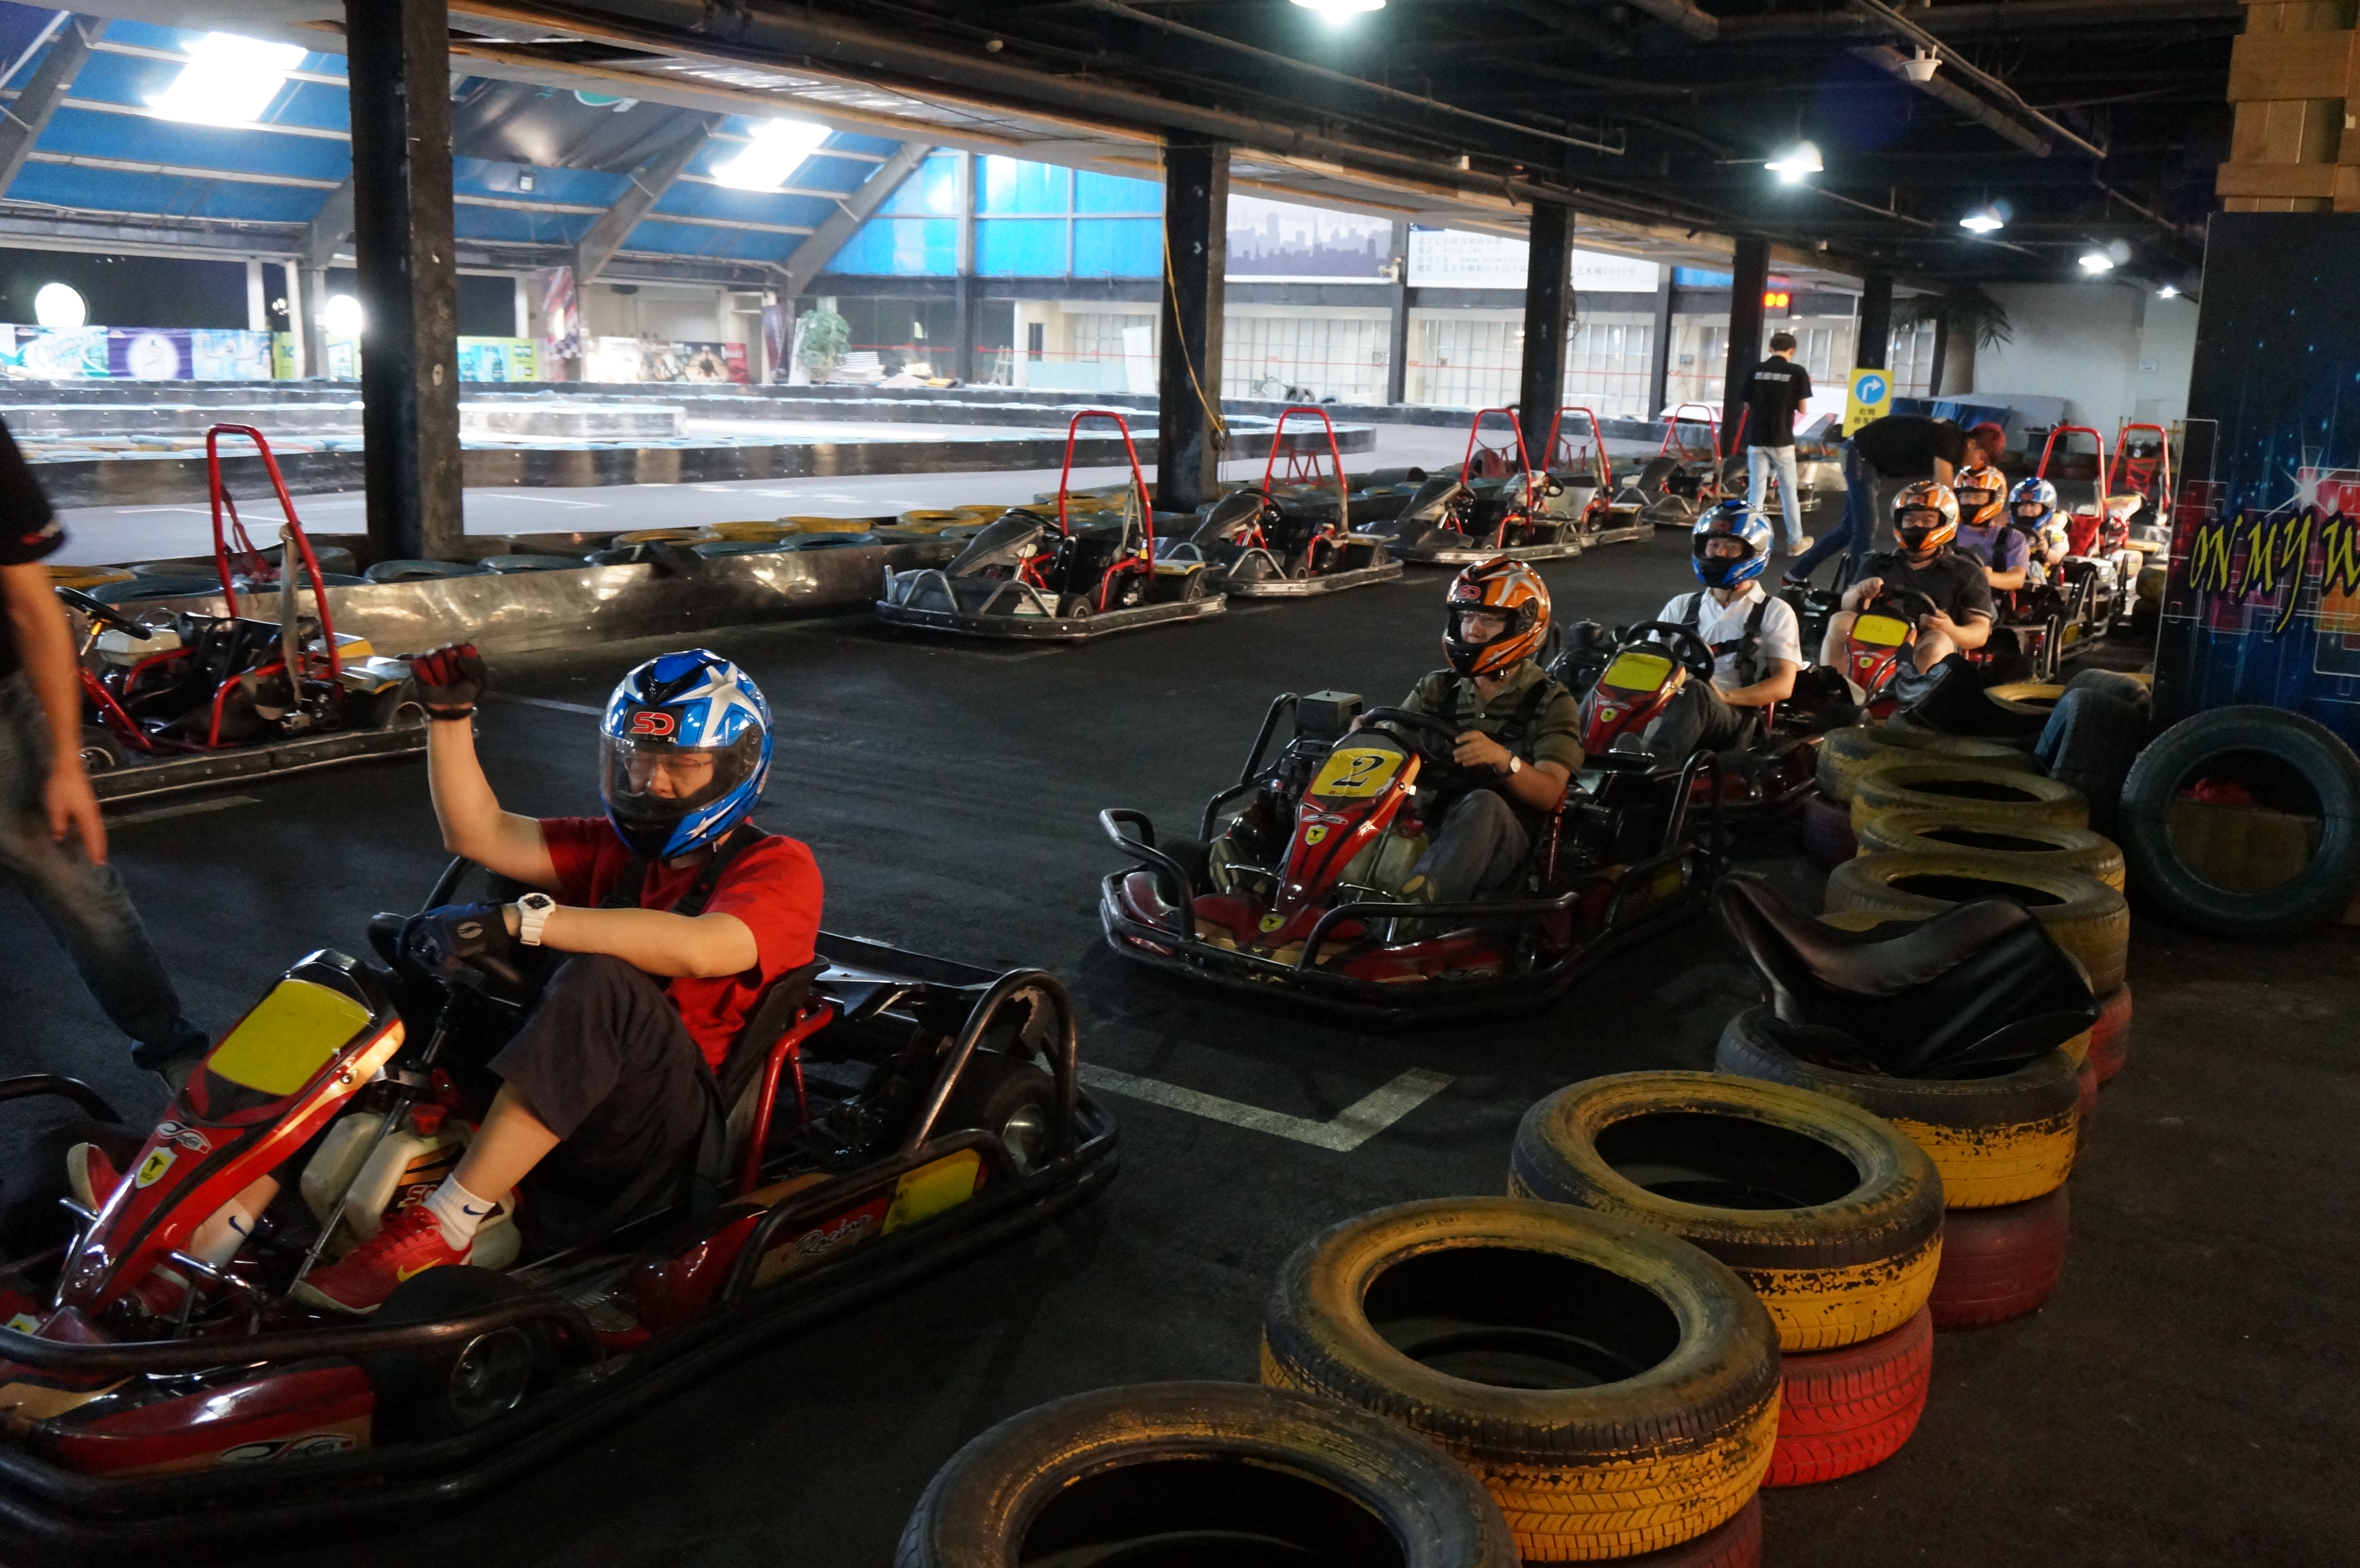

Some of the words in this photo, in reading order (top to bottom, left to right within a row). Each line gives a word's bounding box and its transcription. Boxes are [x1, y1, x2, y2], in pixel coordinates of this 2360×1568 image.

[2189, 514, 2243, 592] ON
[1331, 755, 1385, 788] 2
[796, 1214, 873, 1265] Racing
